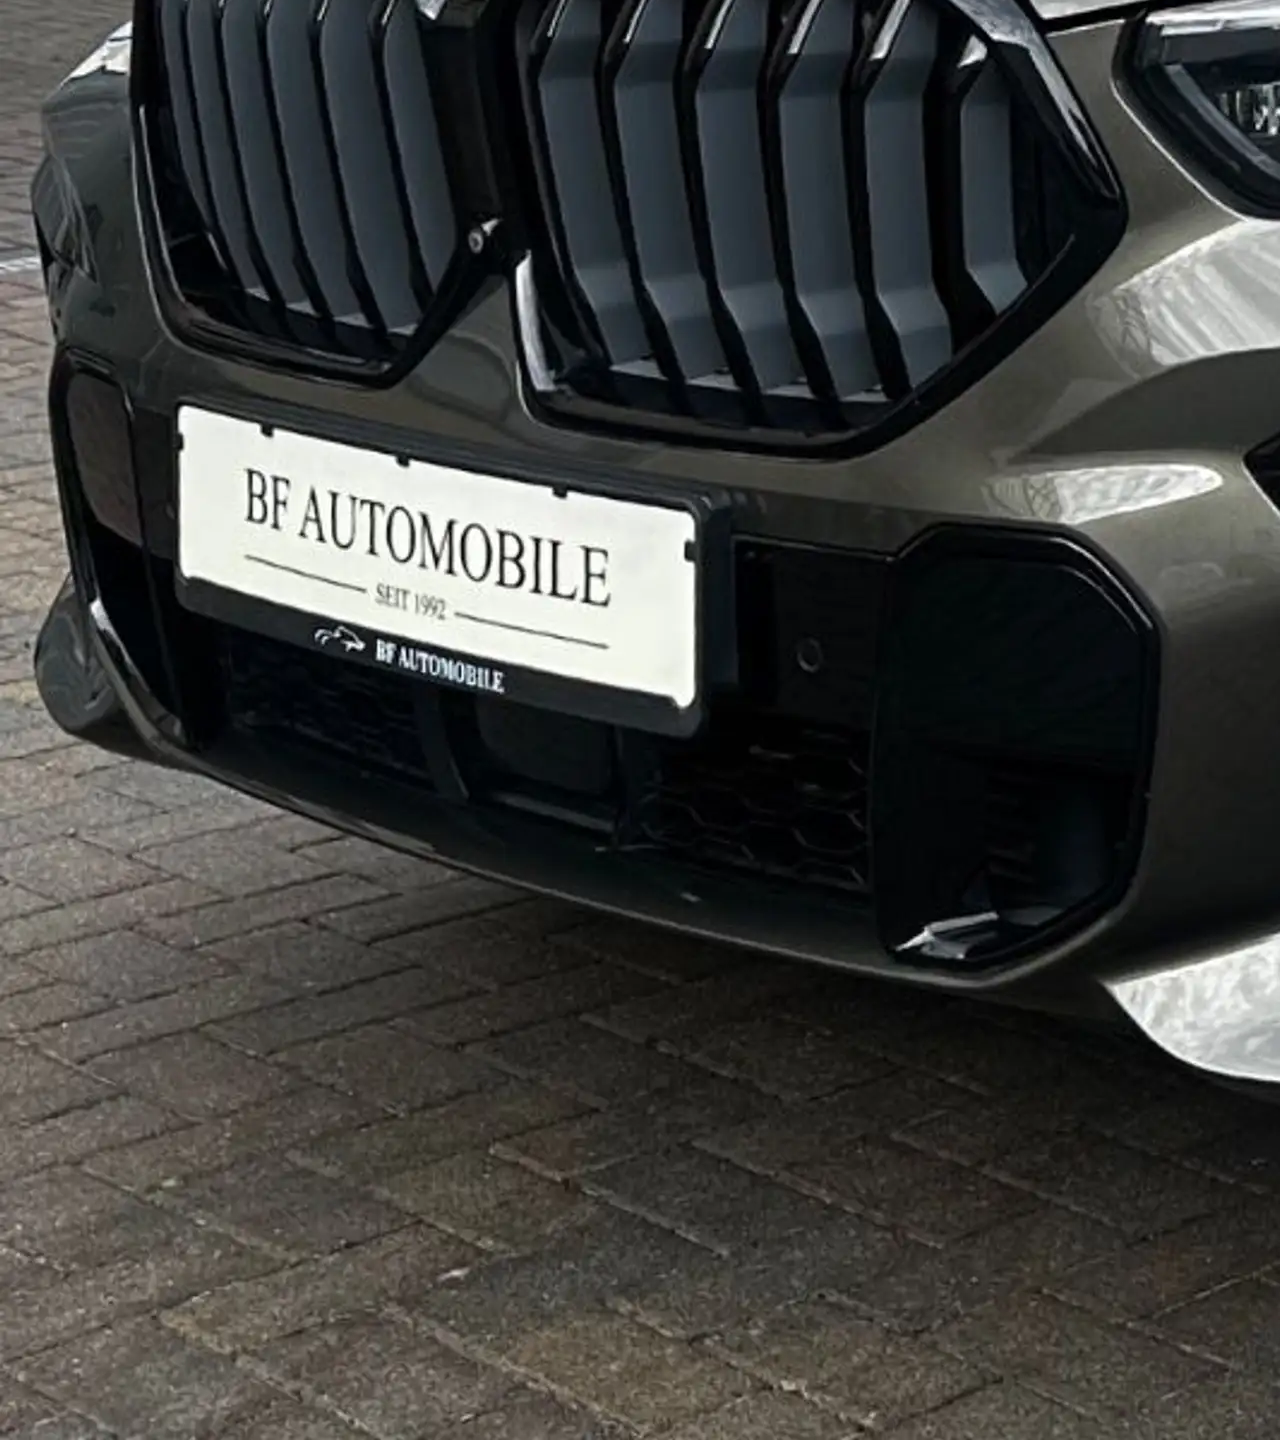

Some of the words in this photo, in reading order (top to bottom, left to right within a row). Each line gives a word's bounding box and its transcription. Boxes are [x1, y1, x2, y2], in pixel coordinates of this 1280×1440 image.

[245, 468, 291, 530] BF
[298, 484, 612, 607] AUTOMOBILE
[375, 582, 411, 612] SEIT
[415, 593, 447, 621] 1992
[376, 638, 397, 664] BF
[398, 646, 505, 694] AUTOMOBILE
